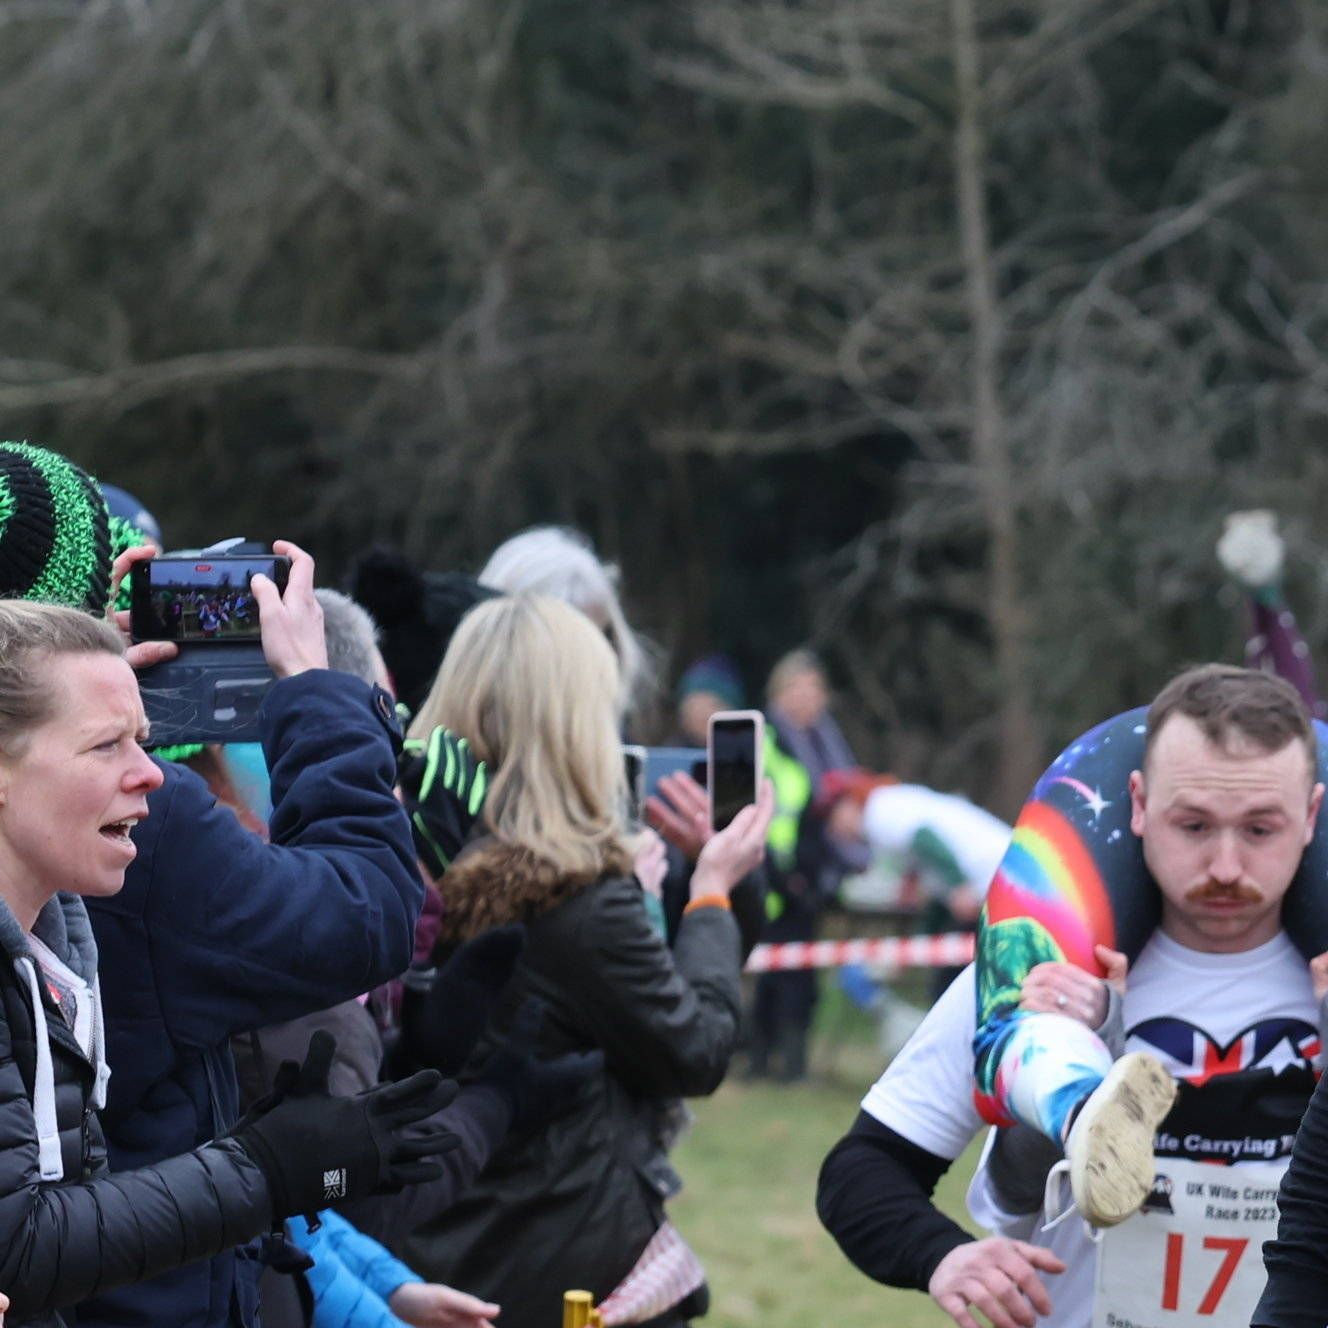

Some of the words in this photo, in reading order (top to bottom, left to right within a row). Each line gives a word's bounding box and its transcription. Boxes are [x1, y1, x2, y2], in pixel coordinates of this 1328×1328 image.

[1184, 1133, 1277, 1158] Carrying
[1185, 1181, 1204, 1196] UK
[1208, 1183, 1239, 1201] Wife
[1243, 1187, 1278, 1201] Carry
[1205, 1204, 1239, 1220] Race
[1244, 1206, 1278, 1221] 2023
[1161, 1231, 1249, 1316] 17
